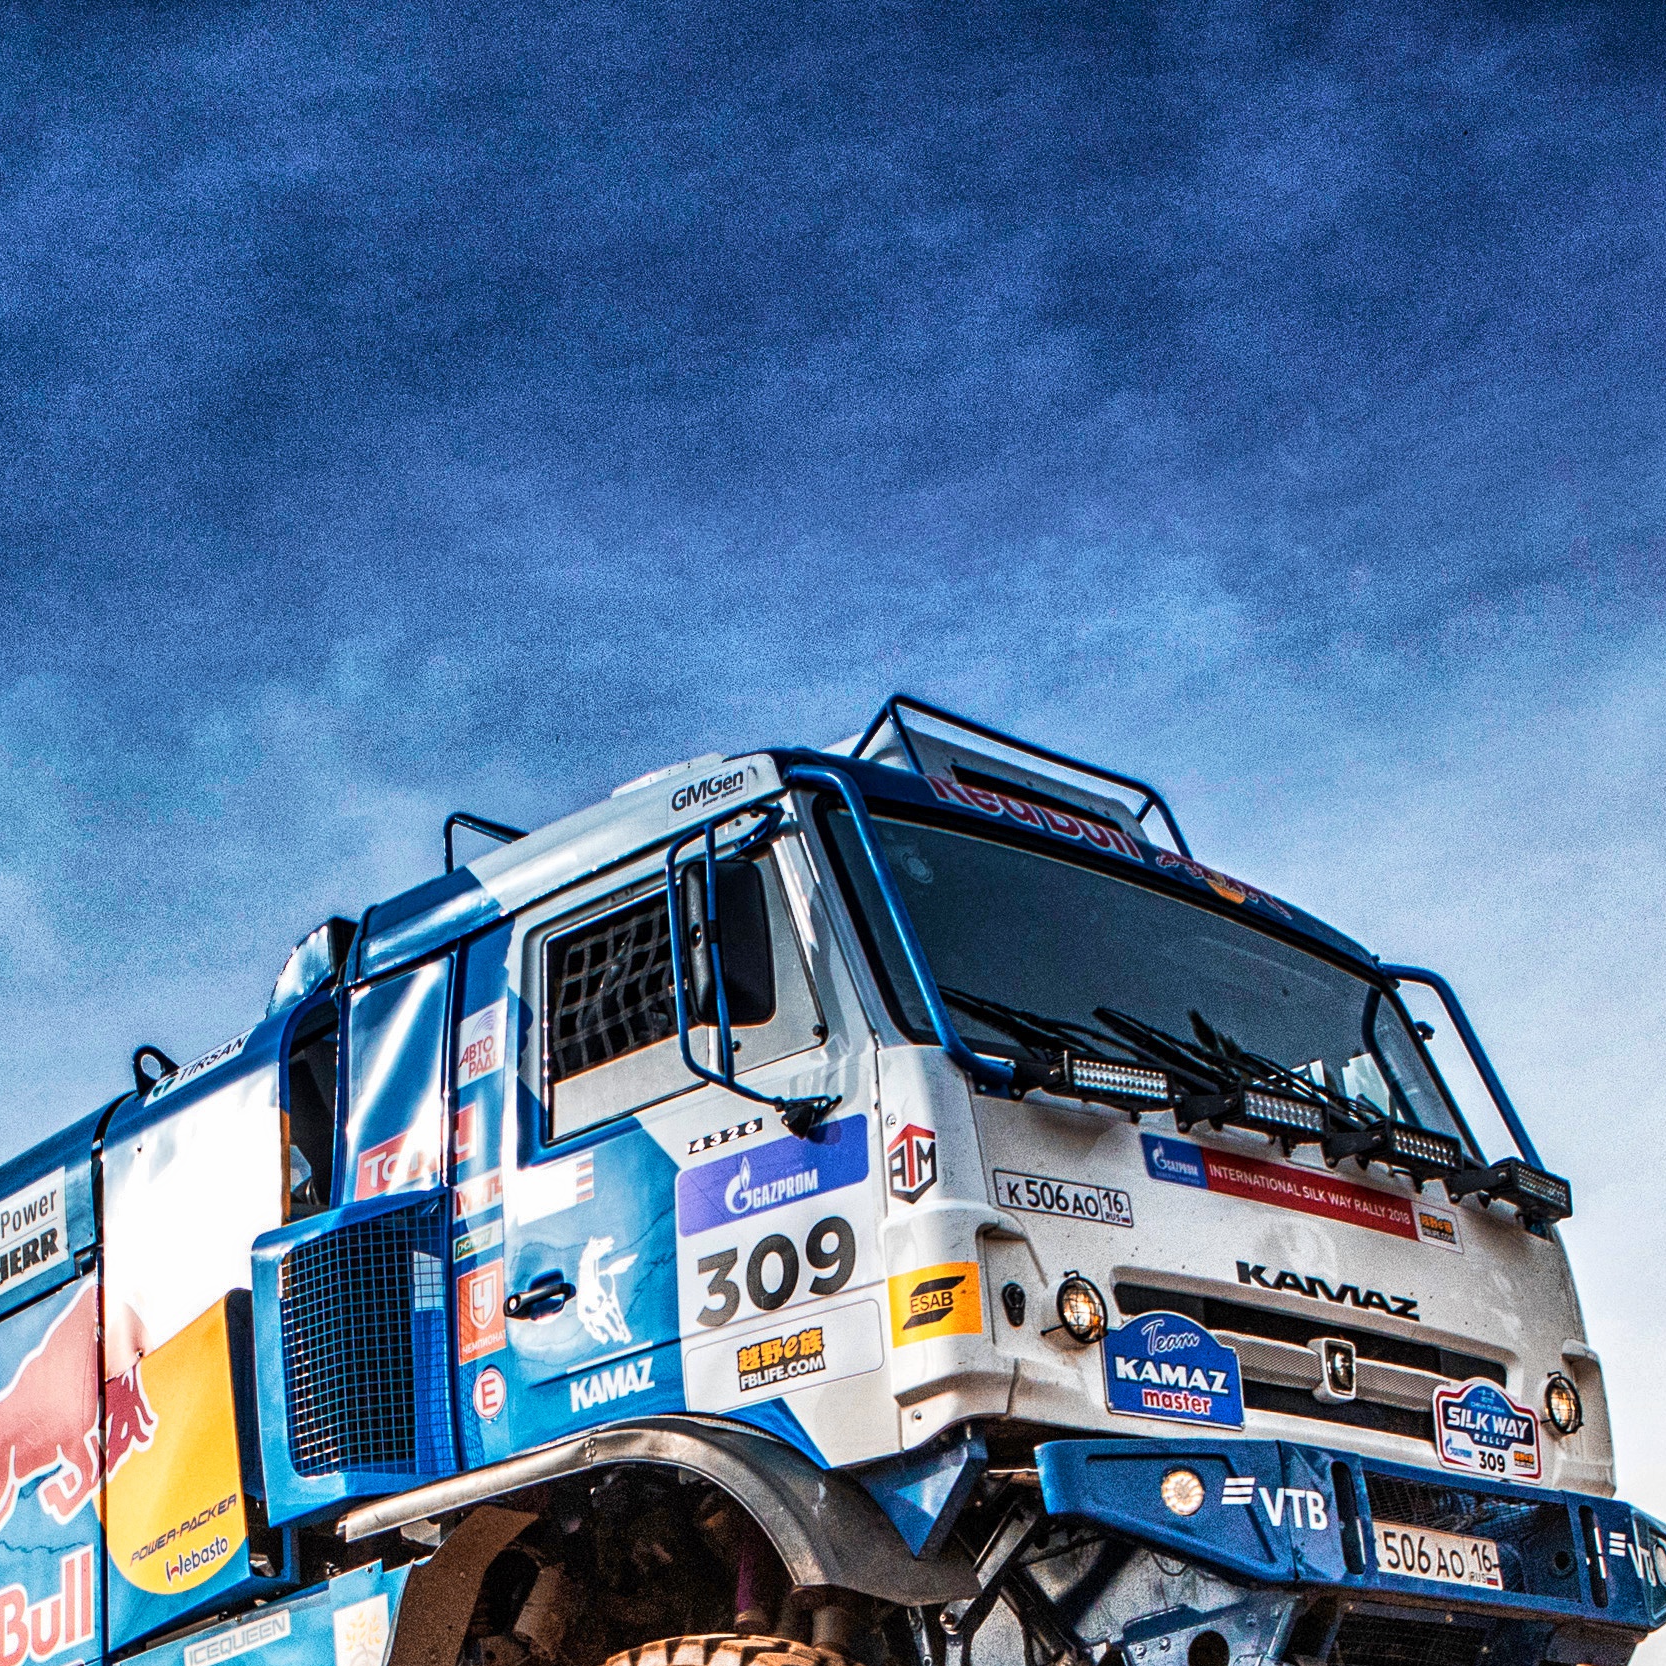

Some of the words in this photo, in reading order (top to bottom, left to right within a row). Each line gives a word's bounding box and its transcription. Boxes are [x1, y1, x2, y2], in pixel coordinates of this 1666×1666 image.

[672, 771, 744, 811] GMGen
[752, 1168, 819, 1210] GAZPROM
[1102, 1190, 1124, 1214] 16
[1209, 1164, 1301, 1197] INTERNATIONAL
[1303, 1185, 1326, 1203] SILK
[1328, 1191, 1352, 1209] WAY
[1354, 1198, 1387, 1218] RALLY
[1388, 1207, 1411, 1225] 2018
[696, 1216, 856, 1328] 309
[910, 1289, 954, 1314] ESAB
[1236, 1260, 1420, 1323] KAMAZ
[1141, 1319, 1200, 1356] Team
[570, 1356, 655, 1413] KAMAZ
[740, 1355, 824, 1391] FBLIFE.COM
[1115, 1356, 1229, 1394] KAMAZ
[1141, 1388, 1212, 1415] master
[1447, 1406, 1490, 1433] SILK
[1492, 1415, 1529, 1440] WAY
[1474, 1433, 1508, 1446] RALLY
[1478, 1450, 1505, 1473] 309
[1258, 1487, 1328, 1531] VTB
[165, 1536, 228, 1582] Webasto
